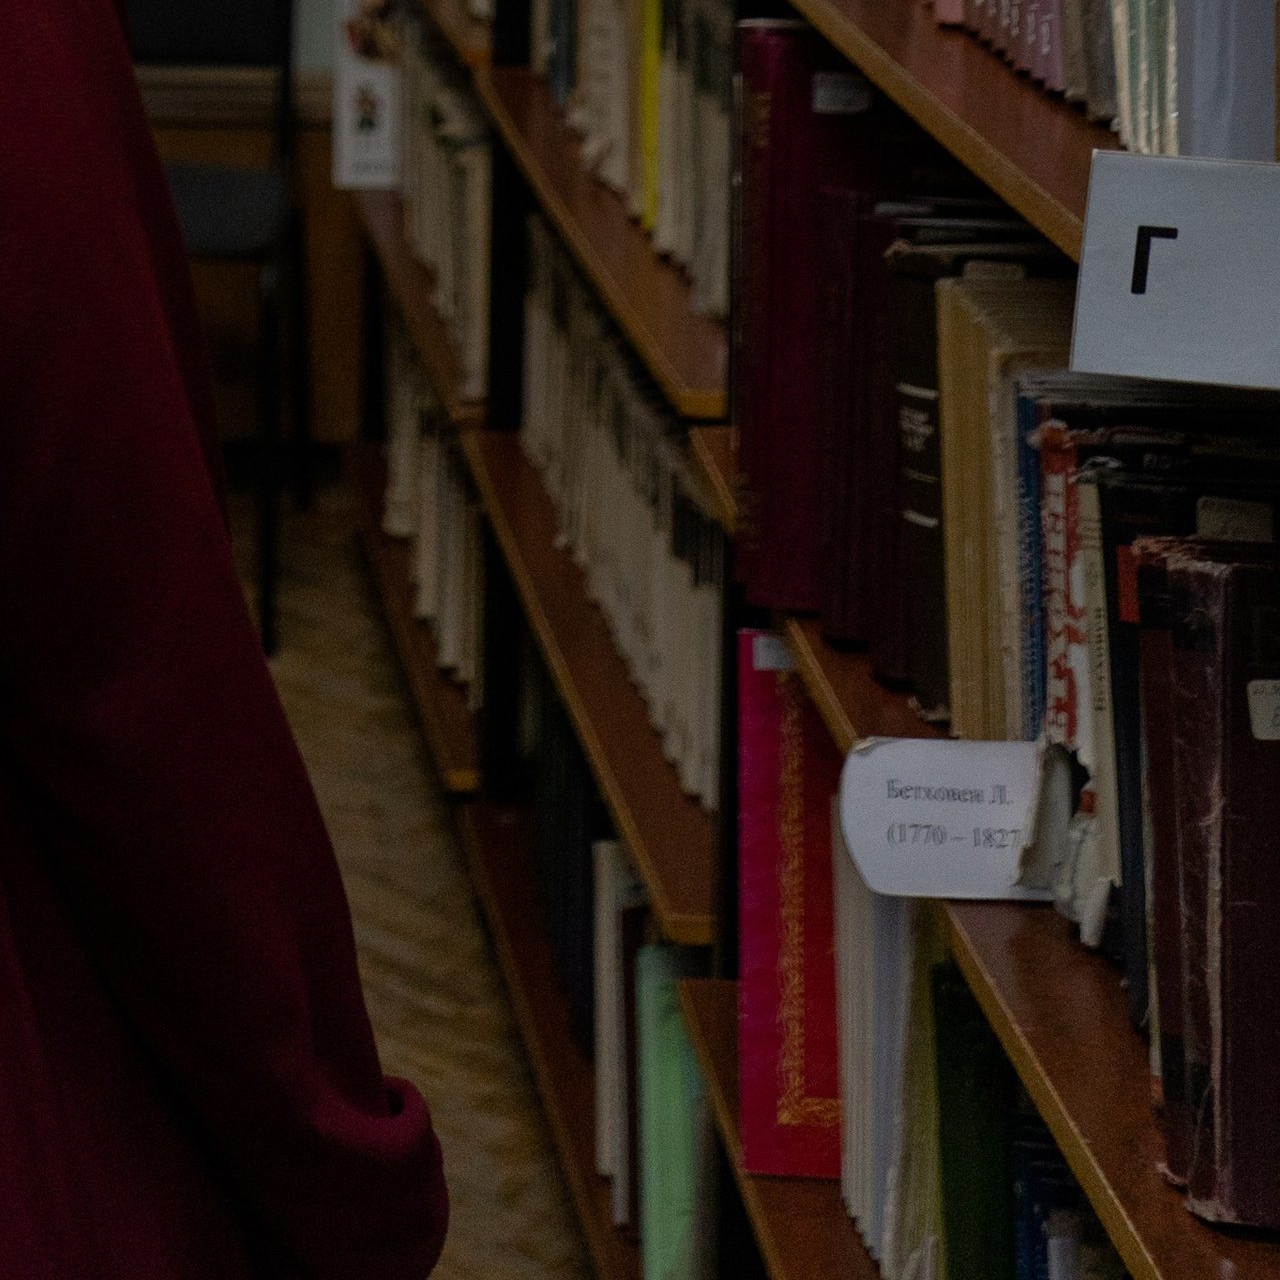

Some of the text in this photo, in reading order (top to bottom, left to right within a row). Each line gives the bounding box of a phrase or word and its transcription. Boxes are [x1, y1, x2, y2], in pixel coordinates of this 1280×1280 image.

[1130, 224, 1179, 295] Г
[886, 779, 1013, 805] Бетховен Л.
[886, 823, 948, 847] (1770
